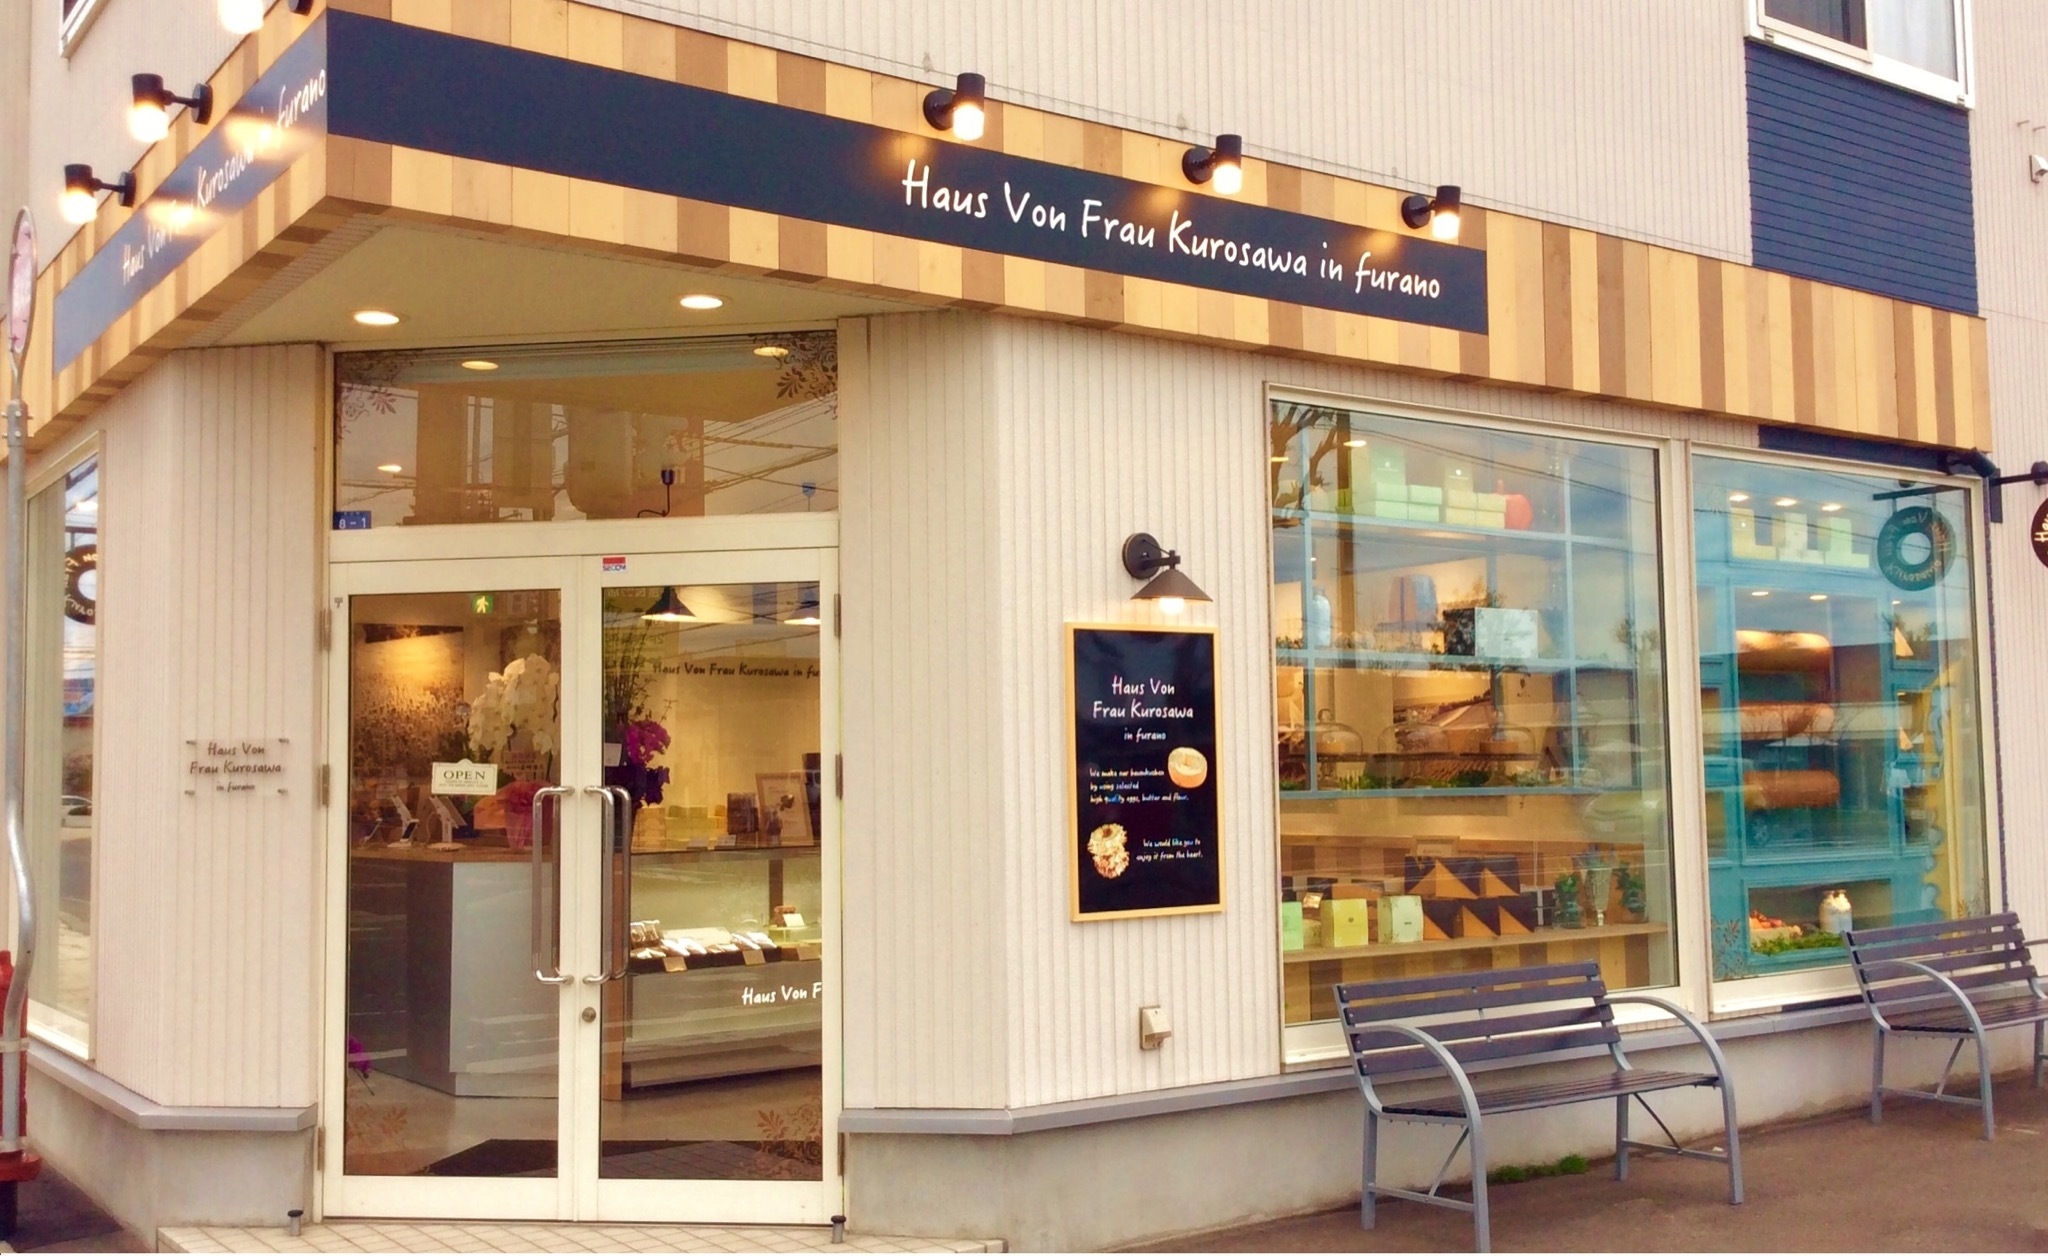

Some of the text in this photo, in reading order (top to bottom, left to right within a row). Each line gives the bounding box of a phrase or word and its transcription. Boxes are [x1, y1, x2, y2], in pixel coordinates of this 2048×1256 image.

[123, 244, 146, 285] Haus
[148, 223, 167, 258] Von
[277, 69, 326, 130] furano
[901, 158, 1441, 299] Haus Von Frau Kurosawa in furano
[653, 662, 680, 675] Haus
[684, 662, 706, 675] Von
[709, 663, 735, 676] Frau
[739, 665, 789, 677] Kurosawa
[793, 665, 803, 676] in
[1111, 674, 1175, 695] Haus Von
[1092, 698, 1194, 718] Frau Kurosawa
[1123, 727, 1167, 743] in furano
[207, 742, 265, 756] Haus Von
[189, 759, 282, 774] Frau Kurosawa
[1089, 767, 1100, 777] We
[443, 770, 486, 780] OPEN
[1090, 781, 1098, 792] by
[1143, 838, 1153, 848] We
[1159, 850, 1175, 861] from
[741, 986, 776, 1005] Haus
[781, 985, 808, 1001] Von
